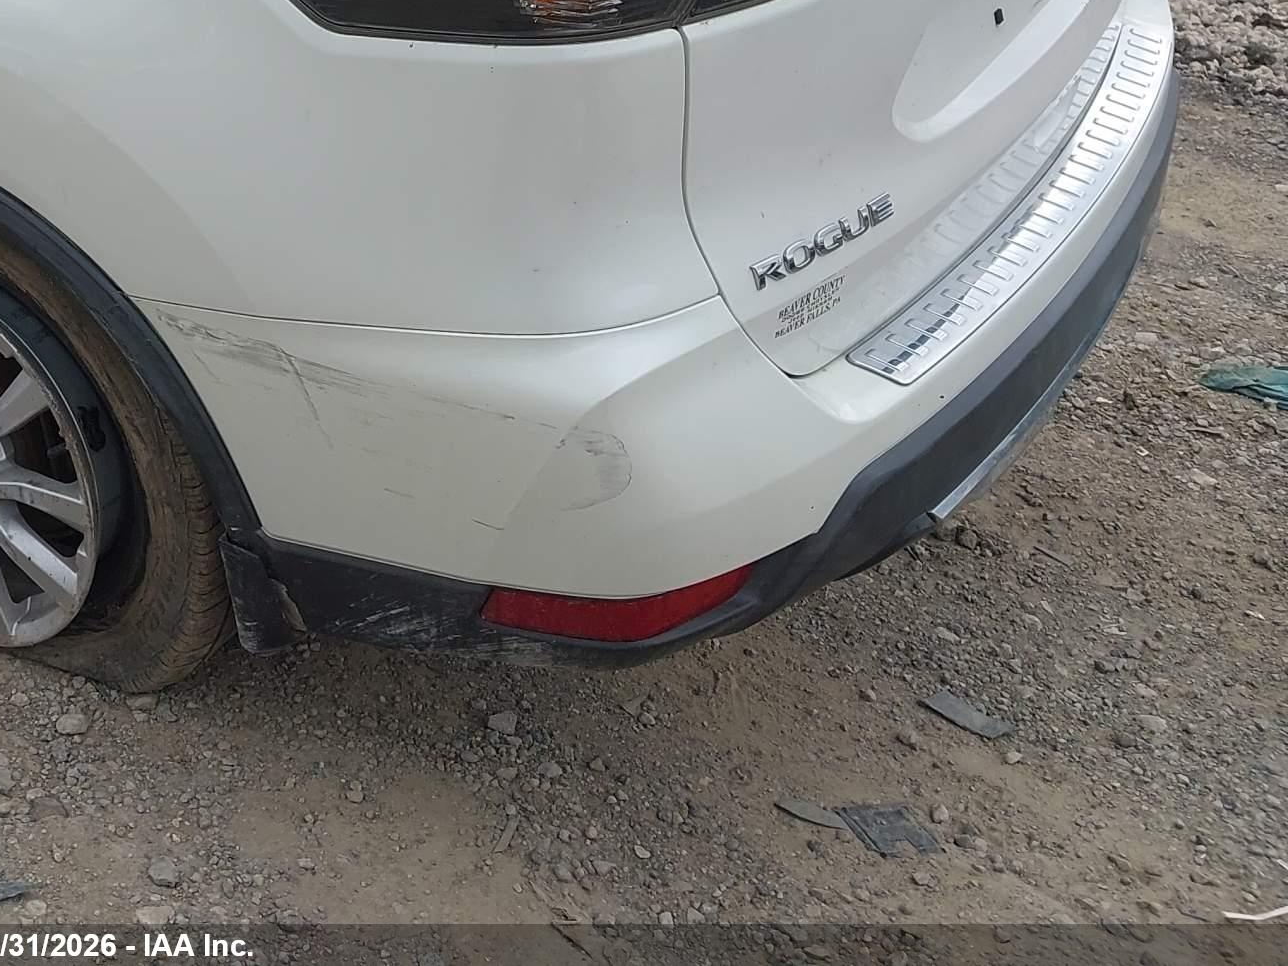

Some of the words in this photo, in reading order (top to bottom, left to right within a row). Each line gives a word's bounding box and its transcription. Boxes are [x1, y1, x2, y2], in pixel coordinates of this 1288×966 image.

[749, 192, 895, 291] ROGUE
[774, 317, 805, 339] BEAVER
[832, 296, 841, 308] PA
[778, 292, 812, 320] BEAVER
[813, 274, 846, 300] COUNTY
